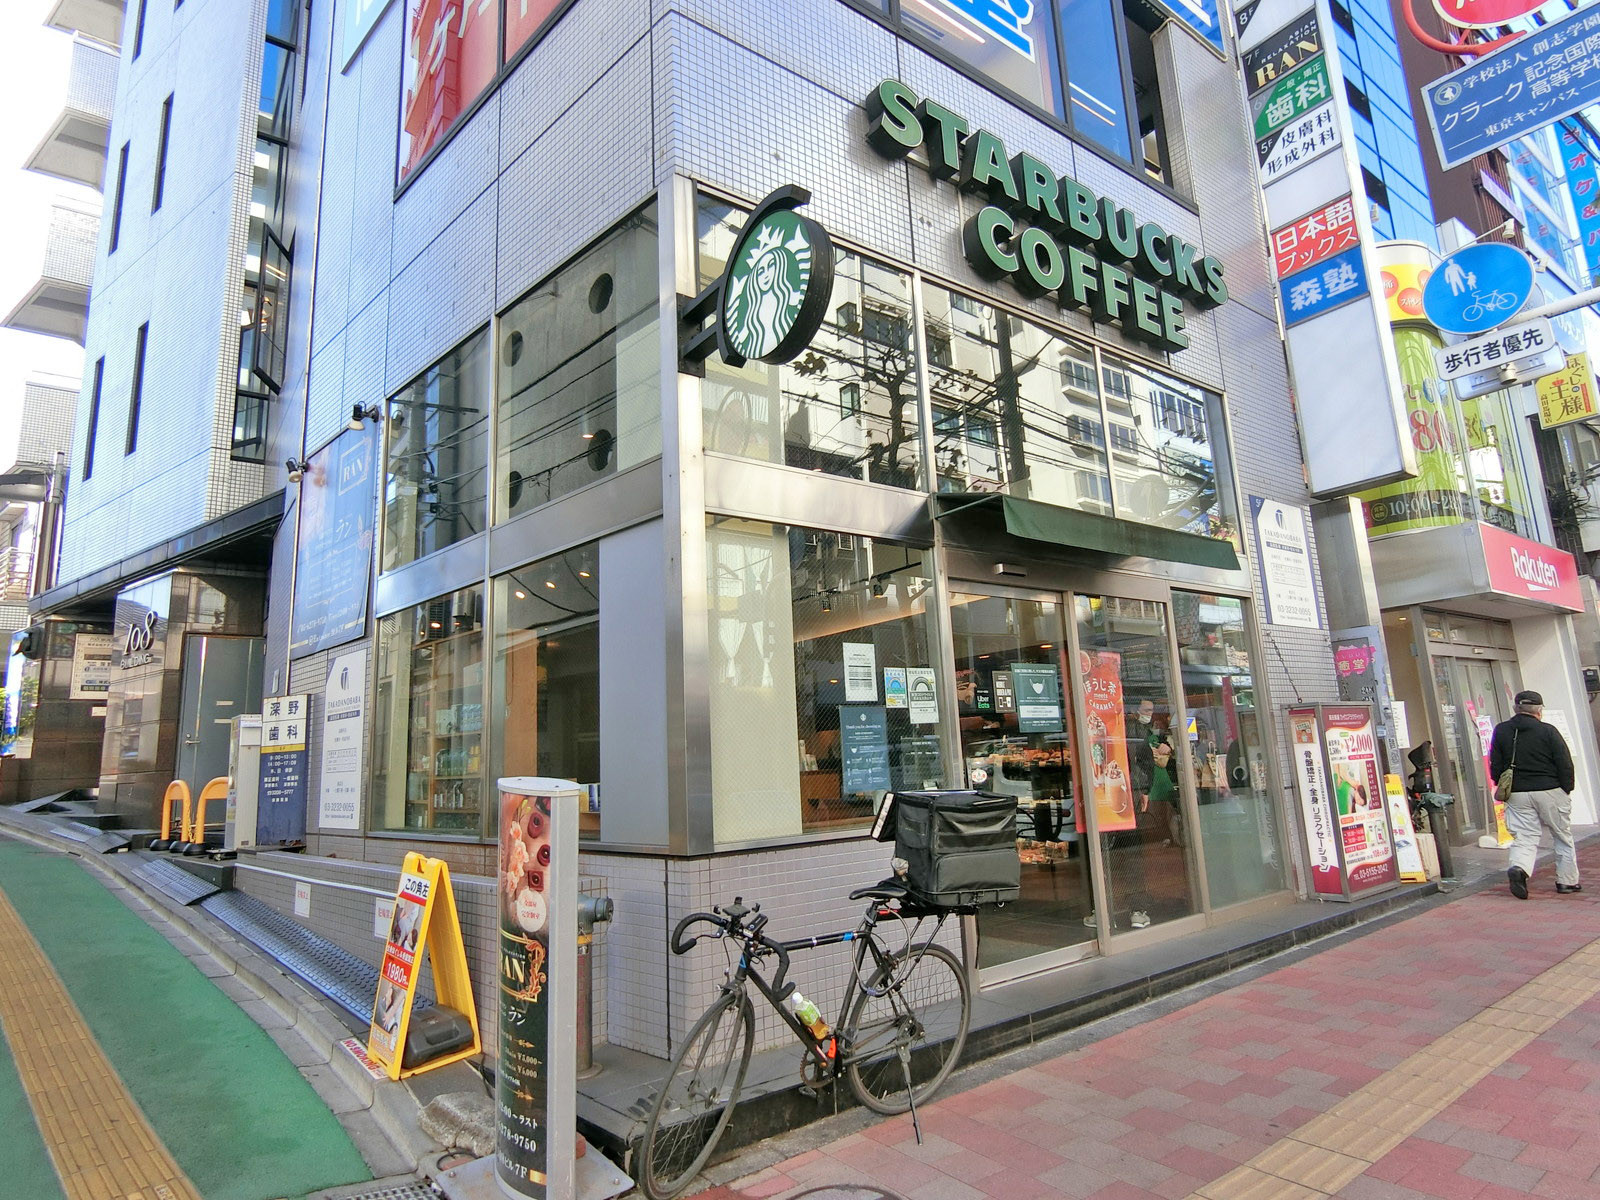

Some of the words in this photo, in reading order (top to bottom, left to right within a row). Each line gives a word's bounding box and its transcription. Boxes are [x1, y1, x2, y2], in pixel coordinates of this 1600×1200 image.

[1239, 7, 1254, 25] 8F
[1289, 19, 1316, 40] ASIAN
[1245, 48, 1260, 66] 7F
[1255, 32, 1319, 88] RAN
[1261, 25, 1317, 63] RELAXATION
[1463, 52, 1528, 89] 学校法人
[1265, 72, 1327, 128] 歯科
[1442, 81, 1524, 132] クラーク
[1260, 138, 1274, 154] 5F
[1281, 108, 1333, 149] 皮膚科
[1267, 126, 1335, 176] 形成外科
[874, 78, 1229, 306] STARBUCKS
[1276, 198, 1353, 254] 日本語
[1279, 226, 1358, 274] ブックス
[972, 206, 1189, 350] COFFEE
[1290, 262, 1359, 312] 森塾
[1443, 327, 1544, 374] 歩行者優先
[1510, 546, 1560, 589] Rakuten
[124, 610, 156, 656] 108
[1083, 678, 1117, 696] ほうじ茶
[1088, 699, 1115, 710] CARAMEL
[269, 701, 299, 717] 深野
[268, 724, 298, 742] 歯科
[405, 878, 429, 898] この角左
[508, 1006, 526, 1026] ラン
[515, 1163, 528, 1178] 7F
